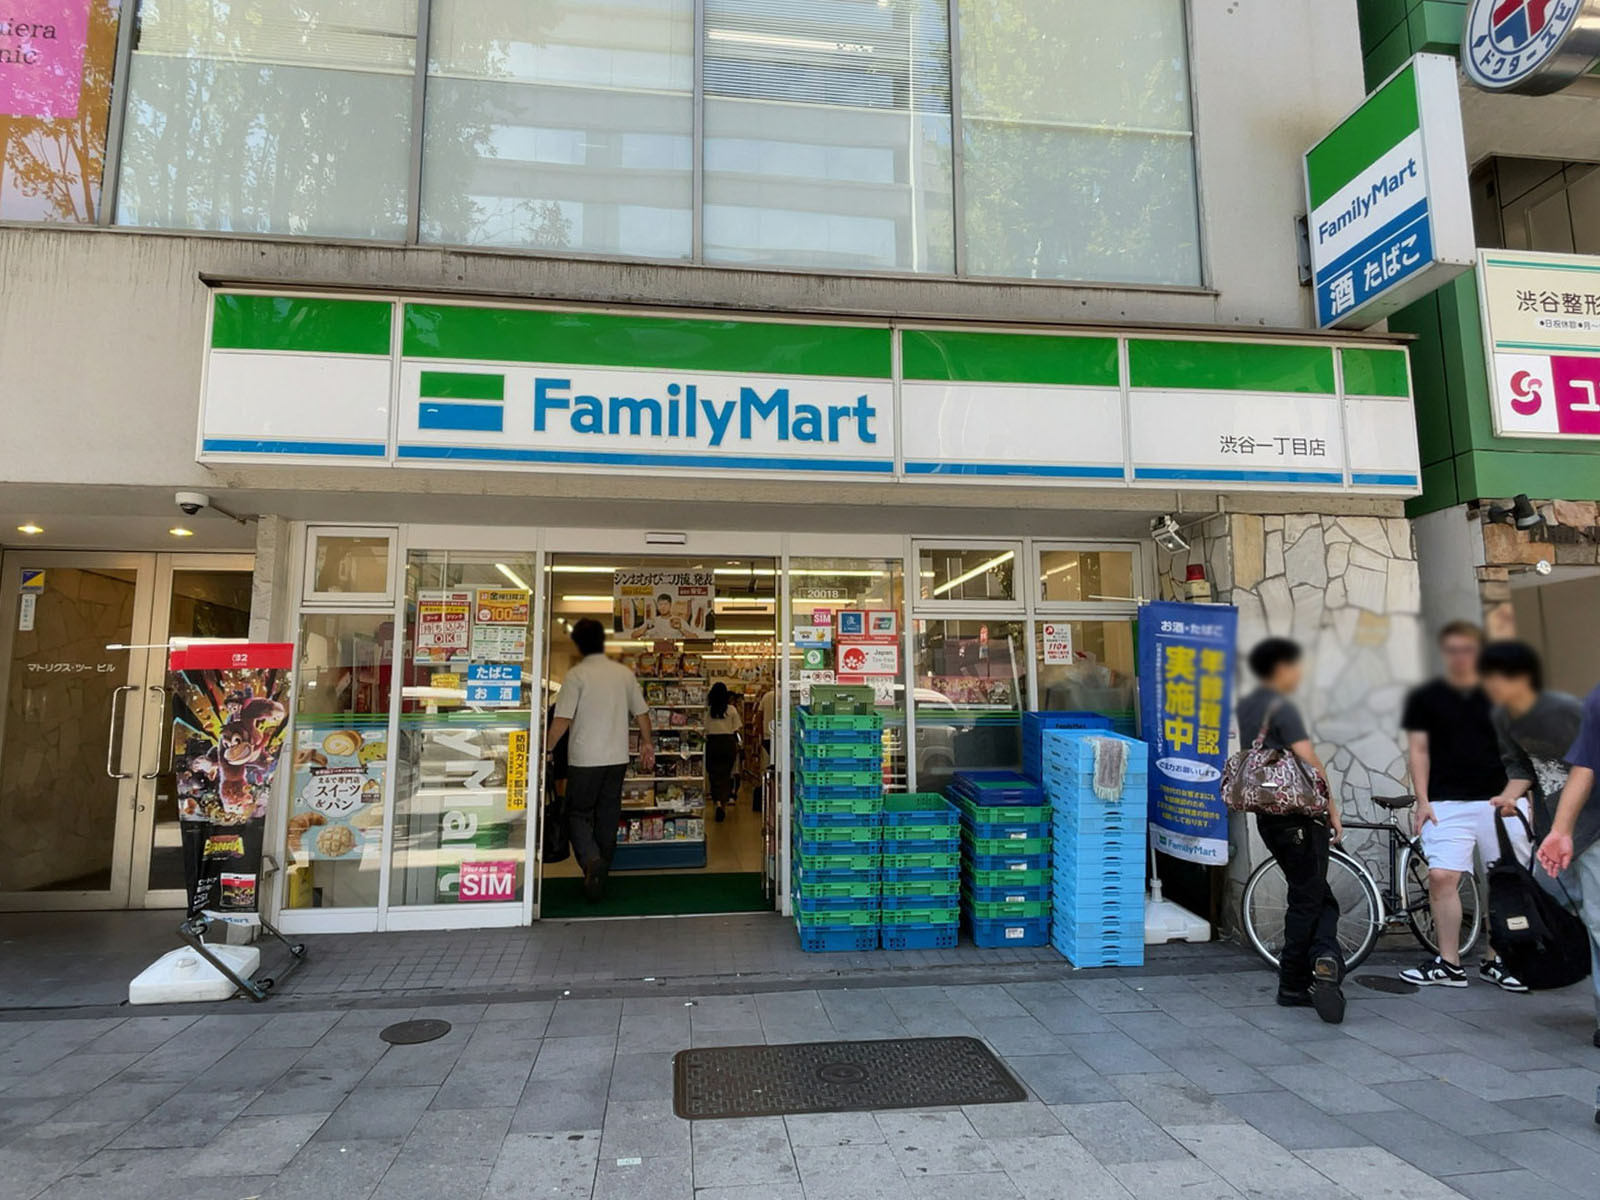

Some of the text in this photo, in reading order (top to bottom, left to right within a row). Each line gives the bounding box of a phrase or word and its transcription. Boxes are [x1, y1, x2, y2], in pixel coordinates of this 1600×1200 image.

[0, 17, 57, 40] iera
[1318, 157, 1418, 246] FamilyMart
[1329, 232, 1421, 316] 酒 たばこ
[1516, 289, 1600, 316] 渋谷整形
[1568, 379, 1600, 413] ユ
[533, 377, 877, 448] FamilyMart
[1219, 434, 1326, 457] 渋谷一丁目店
[807, 589, 839, 598] 20018
[813, 613, 831, 624] SIM
[96, 663, 117, 672] ビル
[476, 667, 513, 679] たばこ
[1164, 645, 1197, 752] 実施中
[1197, 648, 1224, 755] 年確認
[314, 784, 361, 798] スイーツ
[1167, 839, 1217, 858] FamilyMart
[462, 872, 513, 897] SIM
